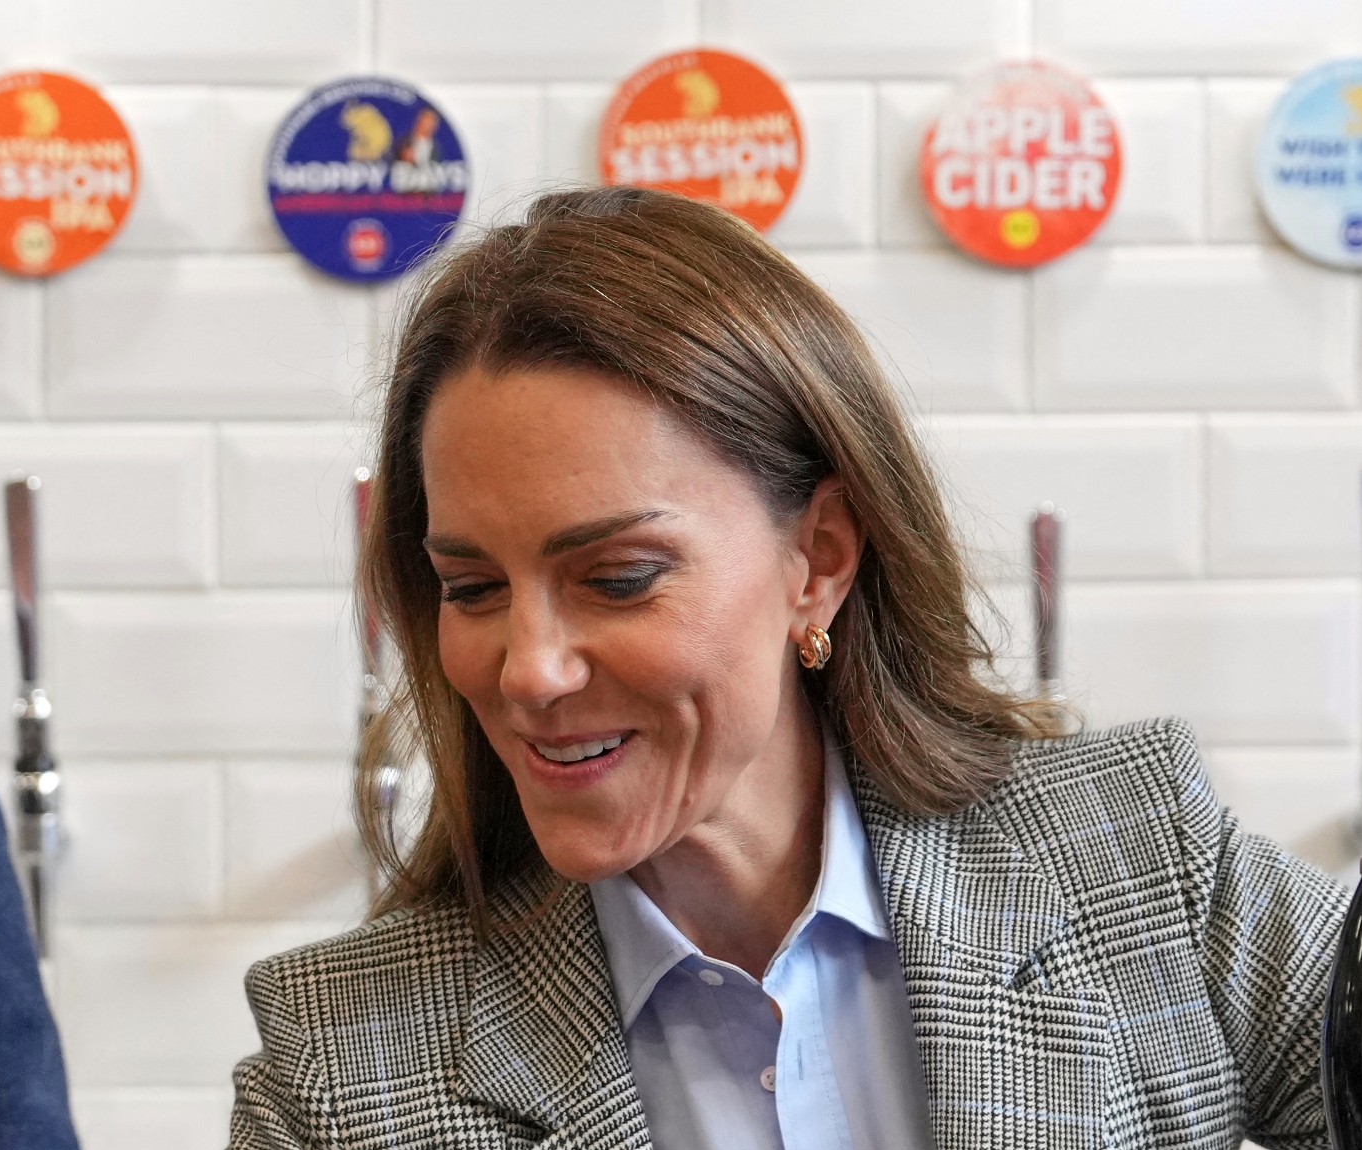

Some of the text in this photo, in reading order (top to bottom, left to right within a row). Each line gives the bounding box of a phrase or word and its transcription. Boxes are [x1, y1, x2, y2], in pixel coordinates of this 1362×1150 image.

[931, 108, 1114, 158] APPLE
[277, 162, 386, 192] HOPPY
[611, 139, 798, 182] SESSION
[937, 159, 1108, 210] CIDER
